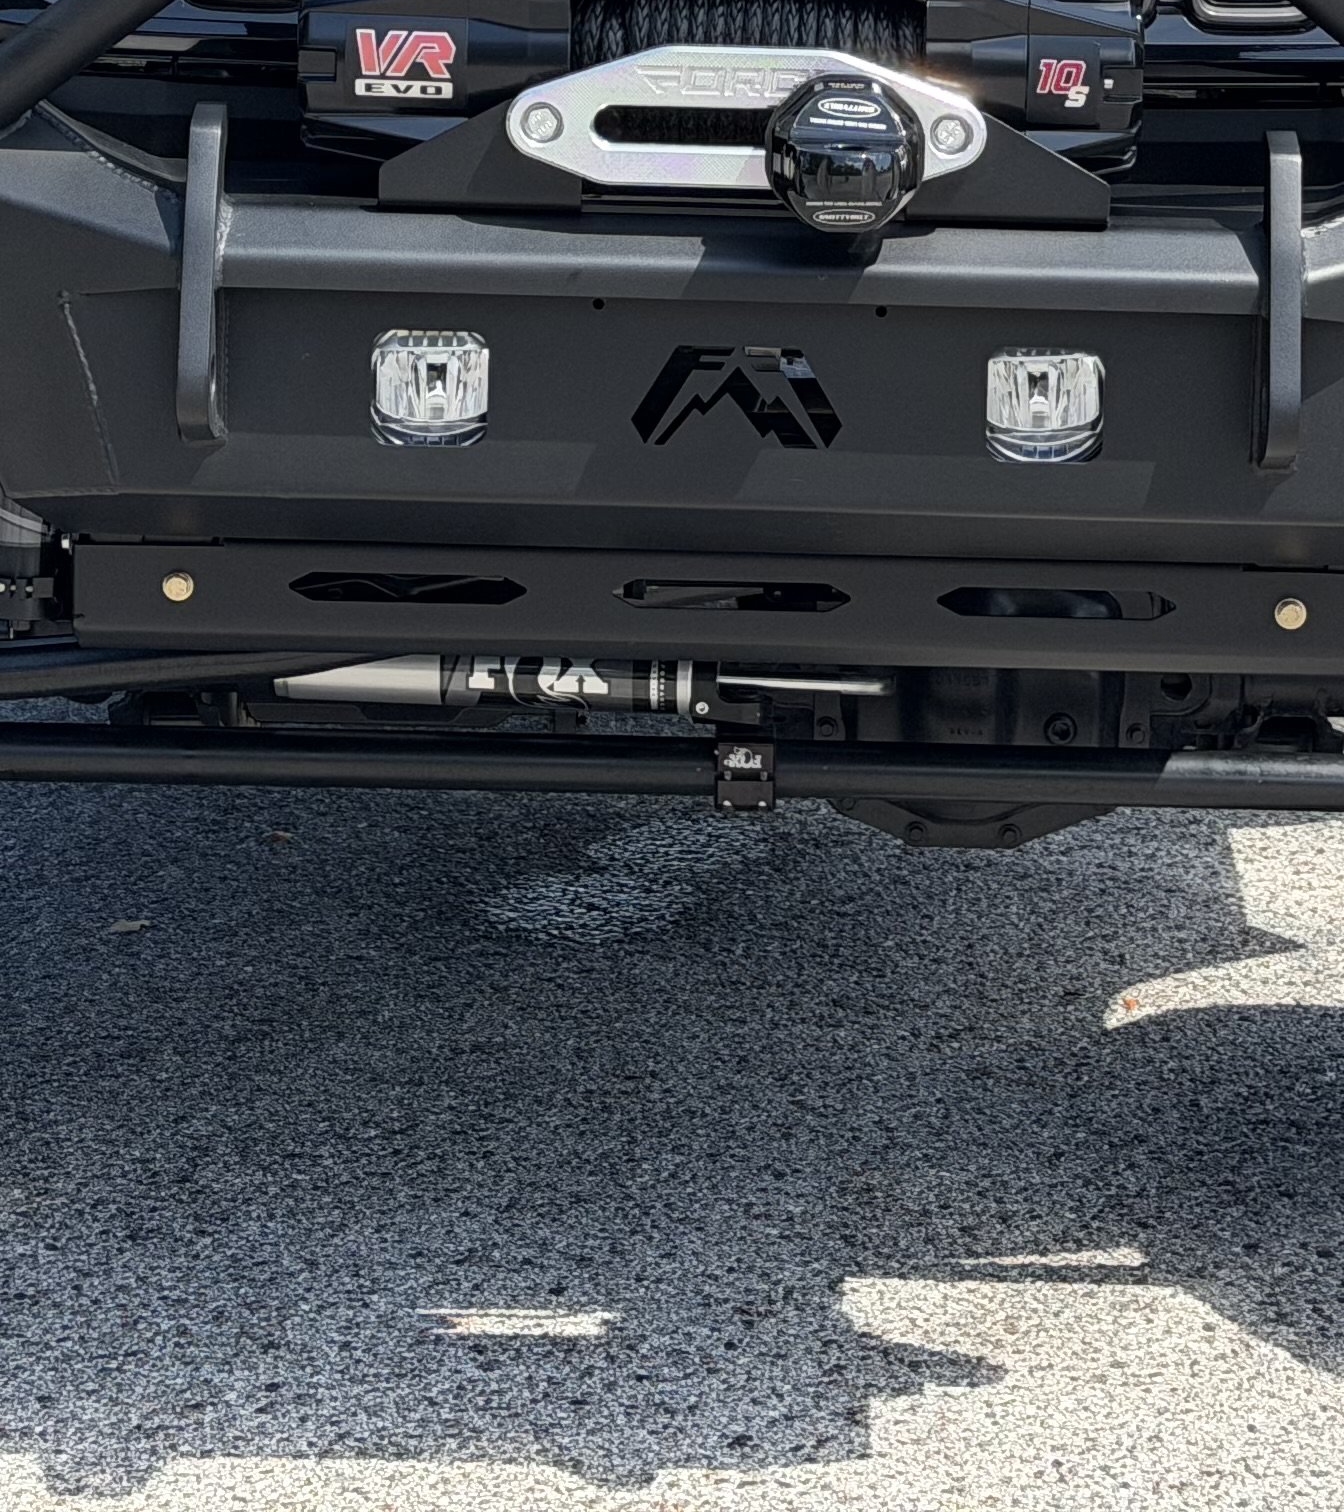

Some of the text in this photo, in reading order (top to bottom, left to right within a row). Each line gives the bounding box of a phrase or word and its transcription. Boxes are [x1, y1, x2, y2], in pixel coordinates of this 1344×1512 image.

[355, 28, 457, 79] VR
[363, 81, 443, 96] EVO
[634, 64, 821, 98] FORC
